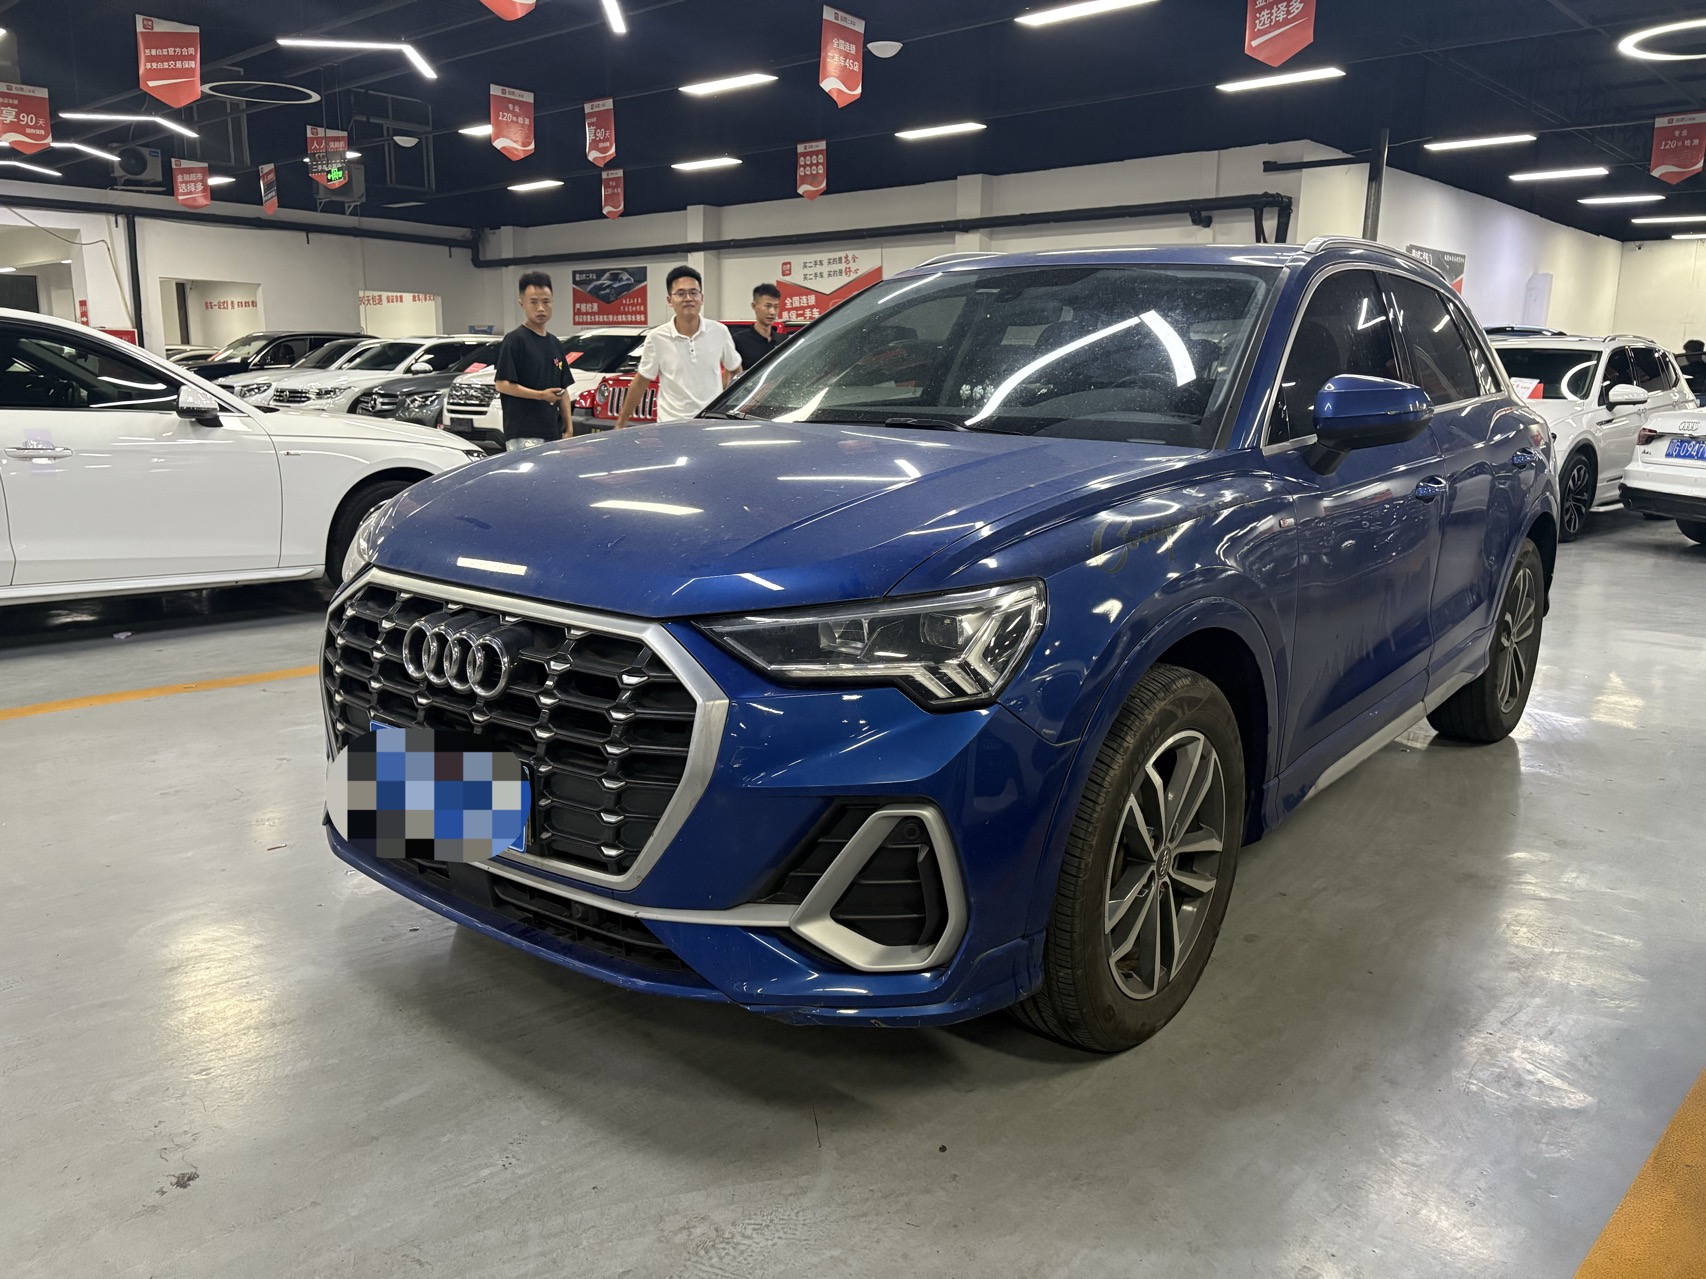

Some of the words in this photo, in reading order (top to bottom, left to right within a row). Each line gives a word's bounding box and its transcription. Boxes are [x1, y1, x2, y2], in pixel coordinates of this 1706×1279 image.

[1254, 0, 1304, 31] 选择多
[832, 37, 856, 55] 全国连锁
[827, 52, 860, 72] 二手车4S店
[178, 182, 205, 193] 选择多
[802, 259, 825, 270] 买二手车
[802, 271, 825, 282] 买二手车
[574, 302, 599, 313] 严格检测
[785, 294, 816, 309] 全国连锁
